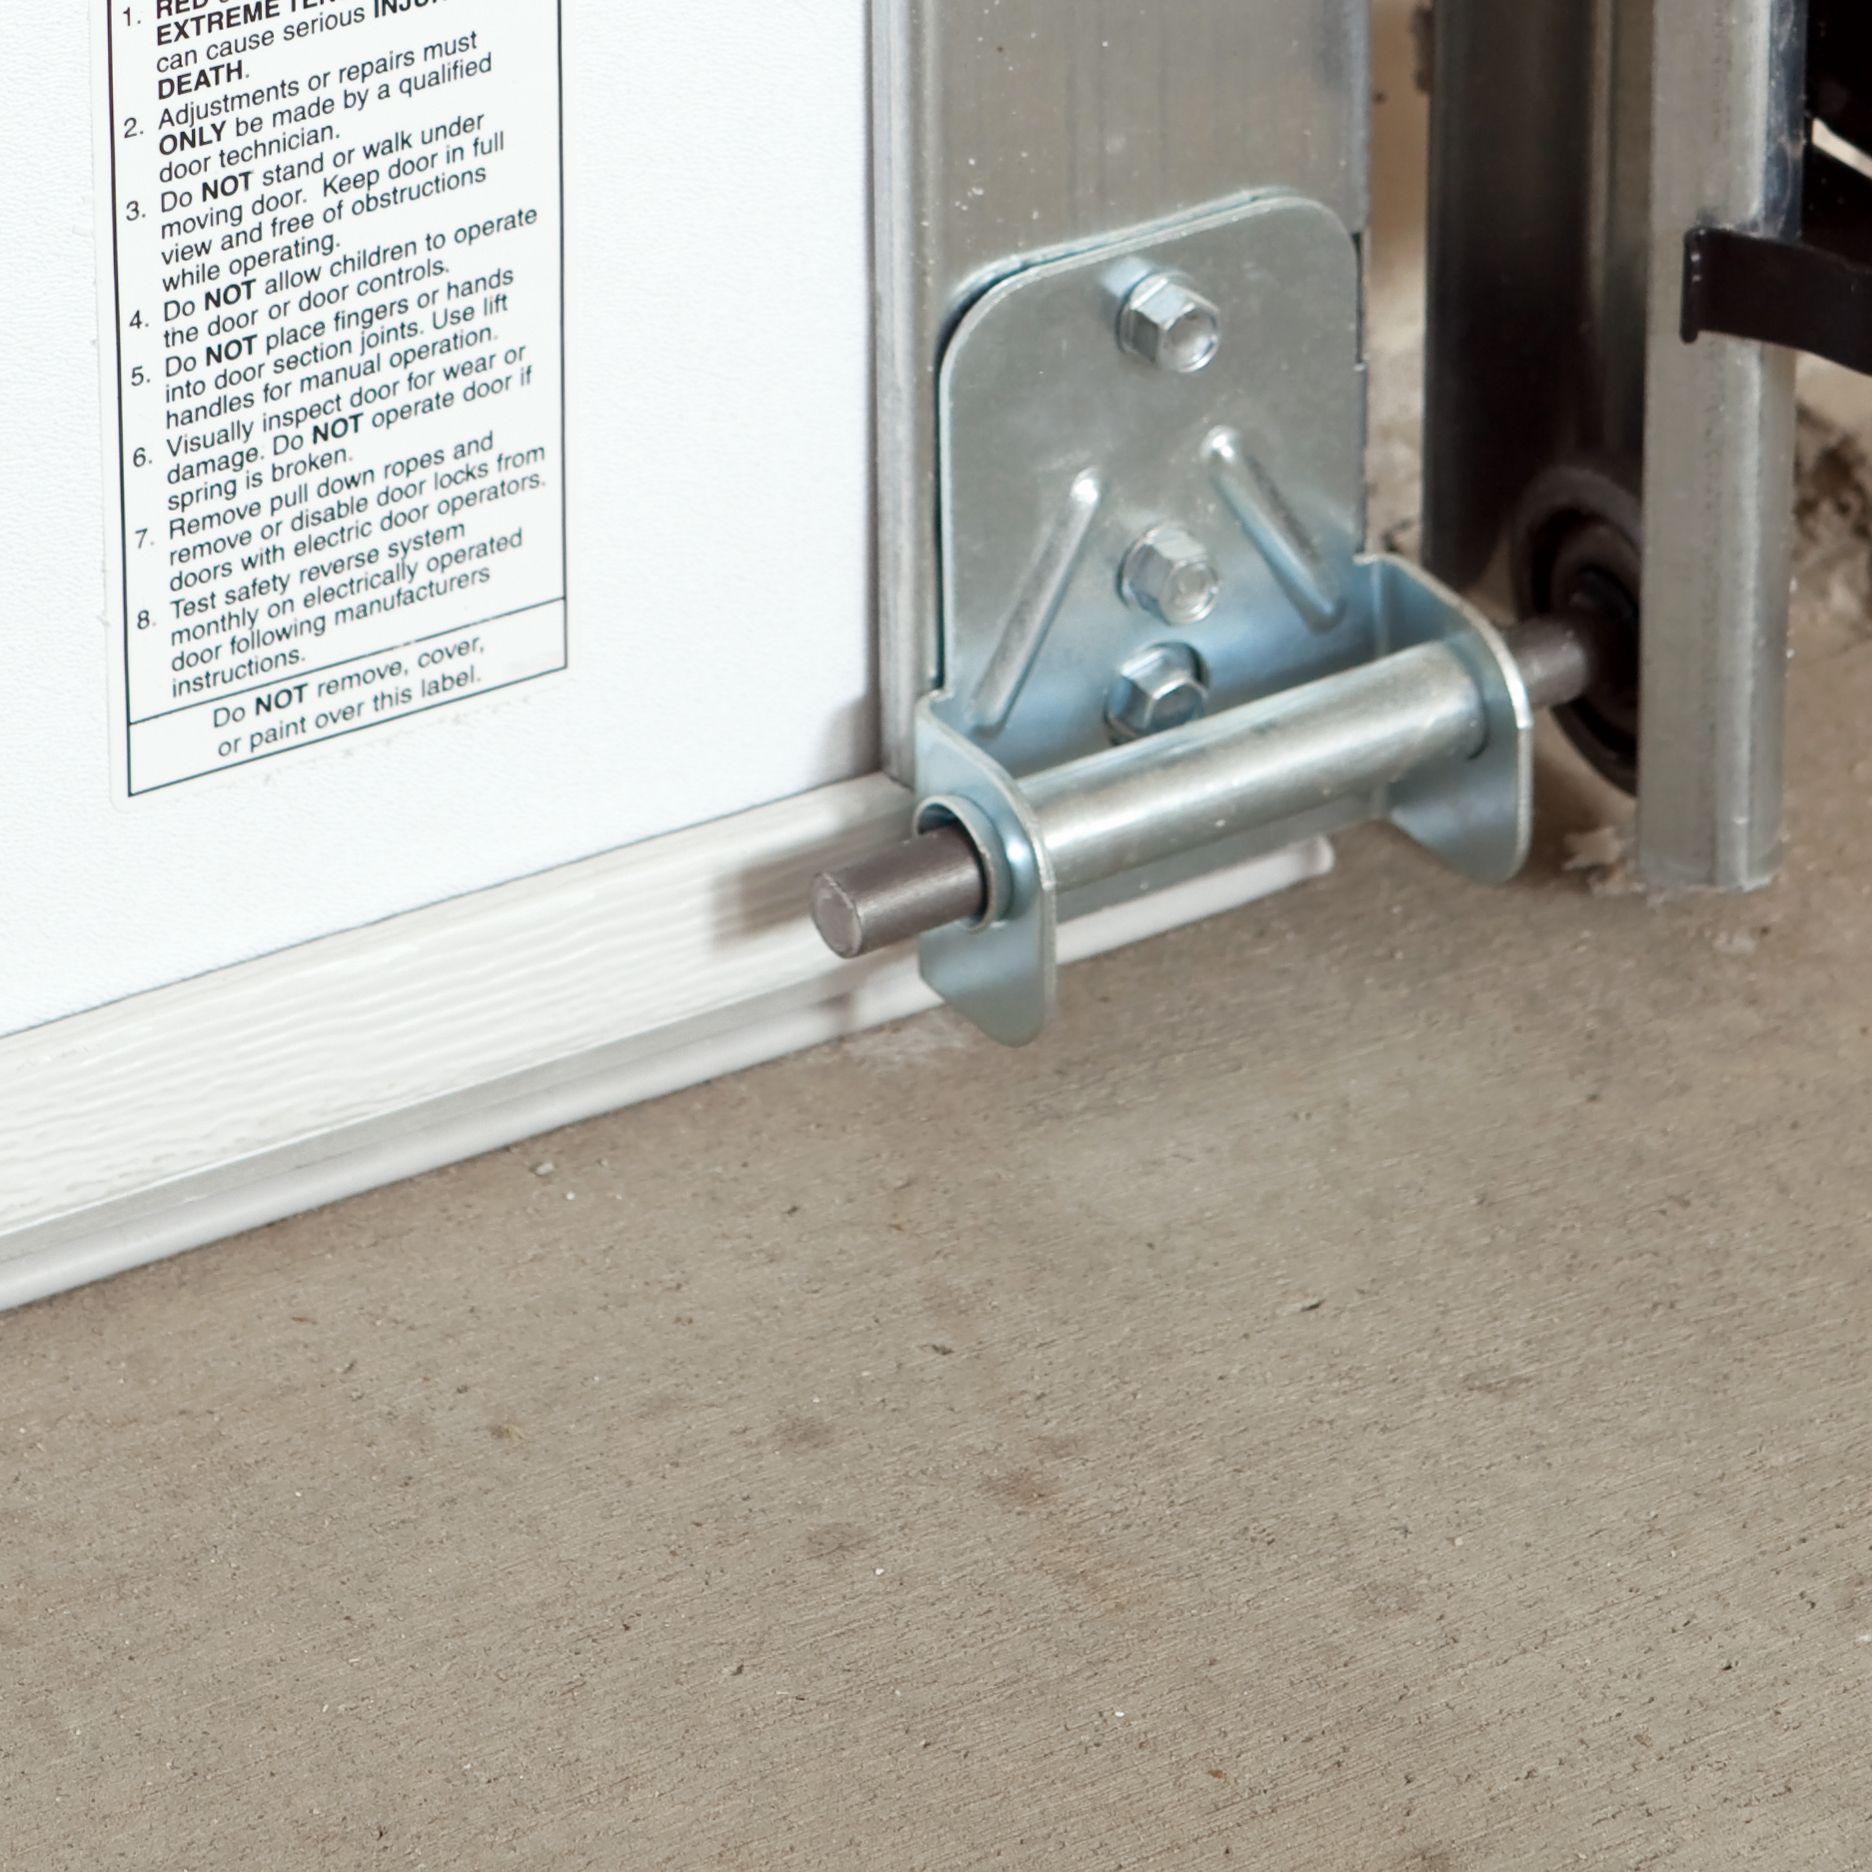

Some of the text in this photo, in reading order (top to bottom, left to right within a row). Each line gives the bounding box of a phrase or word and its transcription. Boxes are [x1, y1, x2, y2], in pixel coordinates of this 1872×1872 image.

[121, 5, 142, 27] 1.
[155, 48, 198, 74] can
[205, 28, 275, 61] cause
[282, 5, 366, 42] serious
[122, 29, 478, 140] 2. Adjustments or repairs must
[156, 58, 250, 101] DEATH.
[157, 50, 493, 157] ONLY be made by a qualified
[125, 112, 485, 222] 3. Do NOT stand or walk under
[158, 123, 341, 184] door technician.
[160, 129, 505, 241] moving door. Keep door in full
[128, 207, 538, 330] 4. Do NOT allow children to operate
[159, 165, 487, 266] view and free of obstructions
[160, 232, 341, 293] while operating.
[130, 266, 515, 388] 5. Do NOT place fingers or hands
[162, 257, 450, 349] the door or door controls.
[164, 292, 508, 404] into door section joints. Use lift
[131, 344, 527, 469] 6. Visually inspect door for wear or
[165, 325, 497, 431] handles for manual operation.
[165, 363, 533, 486] damage. Do NOT operate door if
[134, 429, 494, 550] 7. Remove pull down ropes and
[166, 446, 353, 514] spring is broken.
[168, 445, 545, 567] remove or disable door locks from
[168, 472, 545, 593] doors with electric door operators.
[135, 522, 466, 631] 8. Test safety reverse system
[170, 526, 523, 647] monthly on electrically operated
[170, 566, 491, 673] door following manufacturers
[171, 647, 306, 699] instructions.
[212, 635, 484, 729] Do NOT remove, cover,
[217, 663, 481, 758] or paint over this label.
